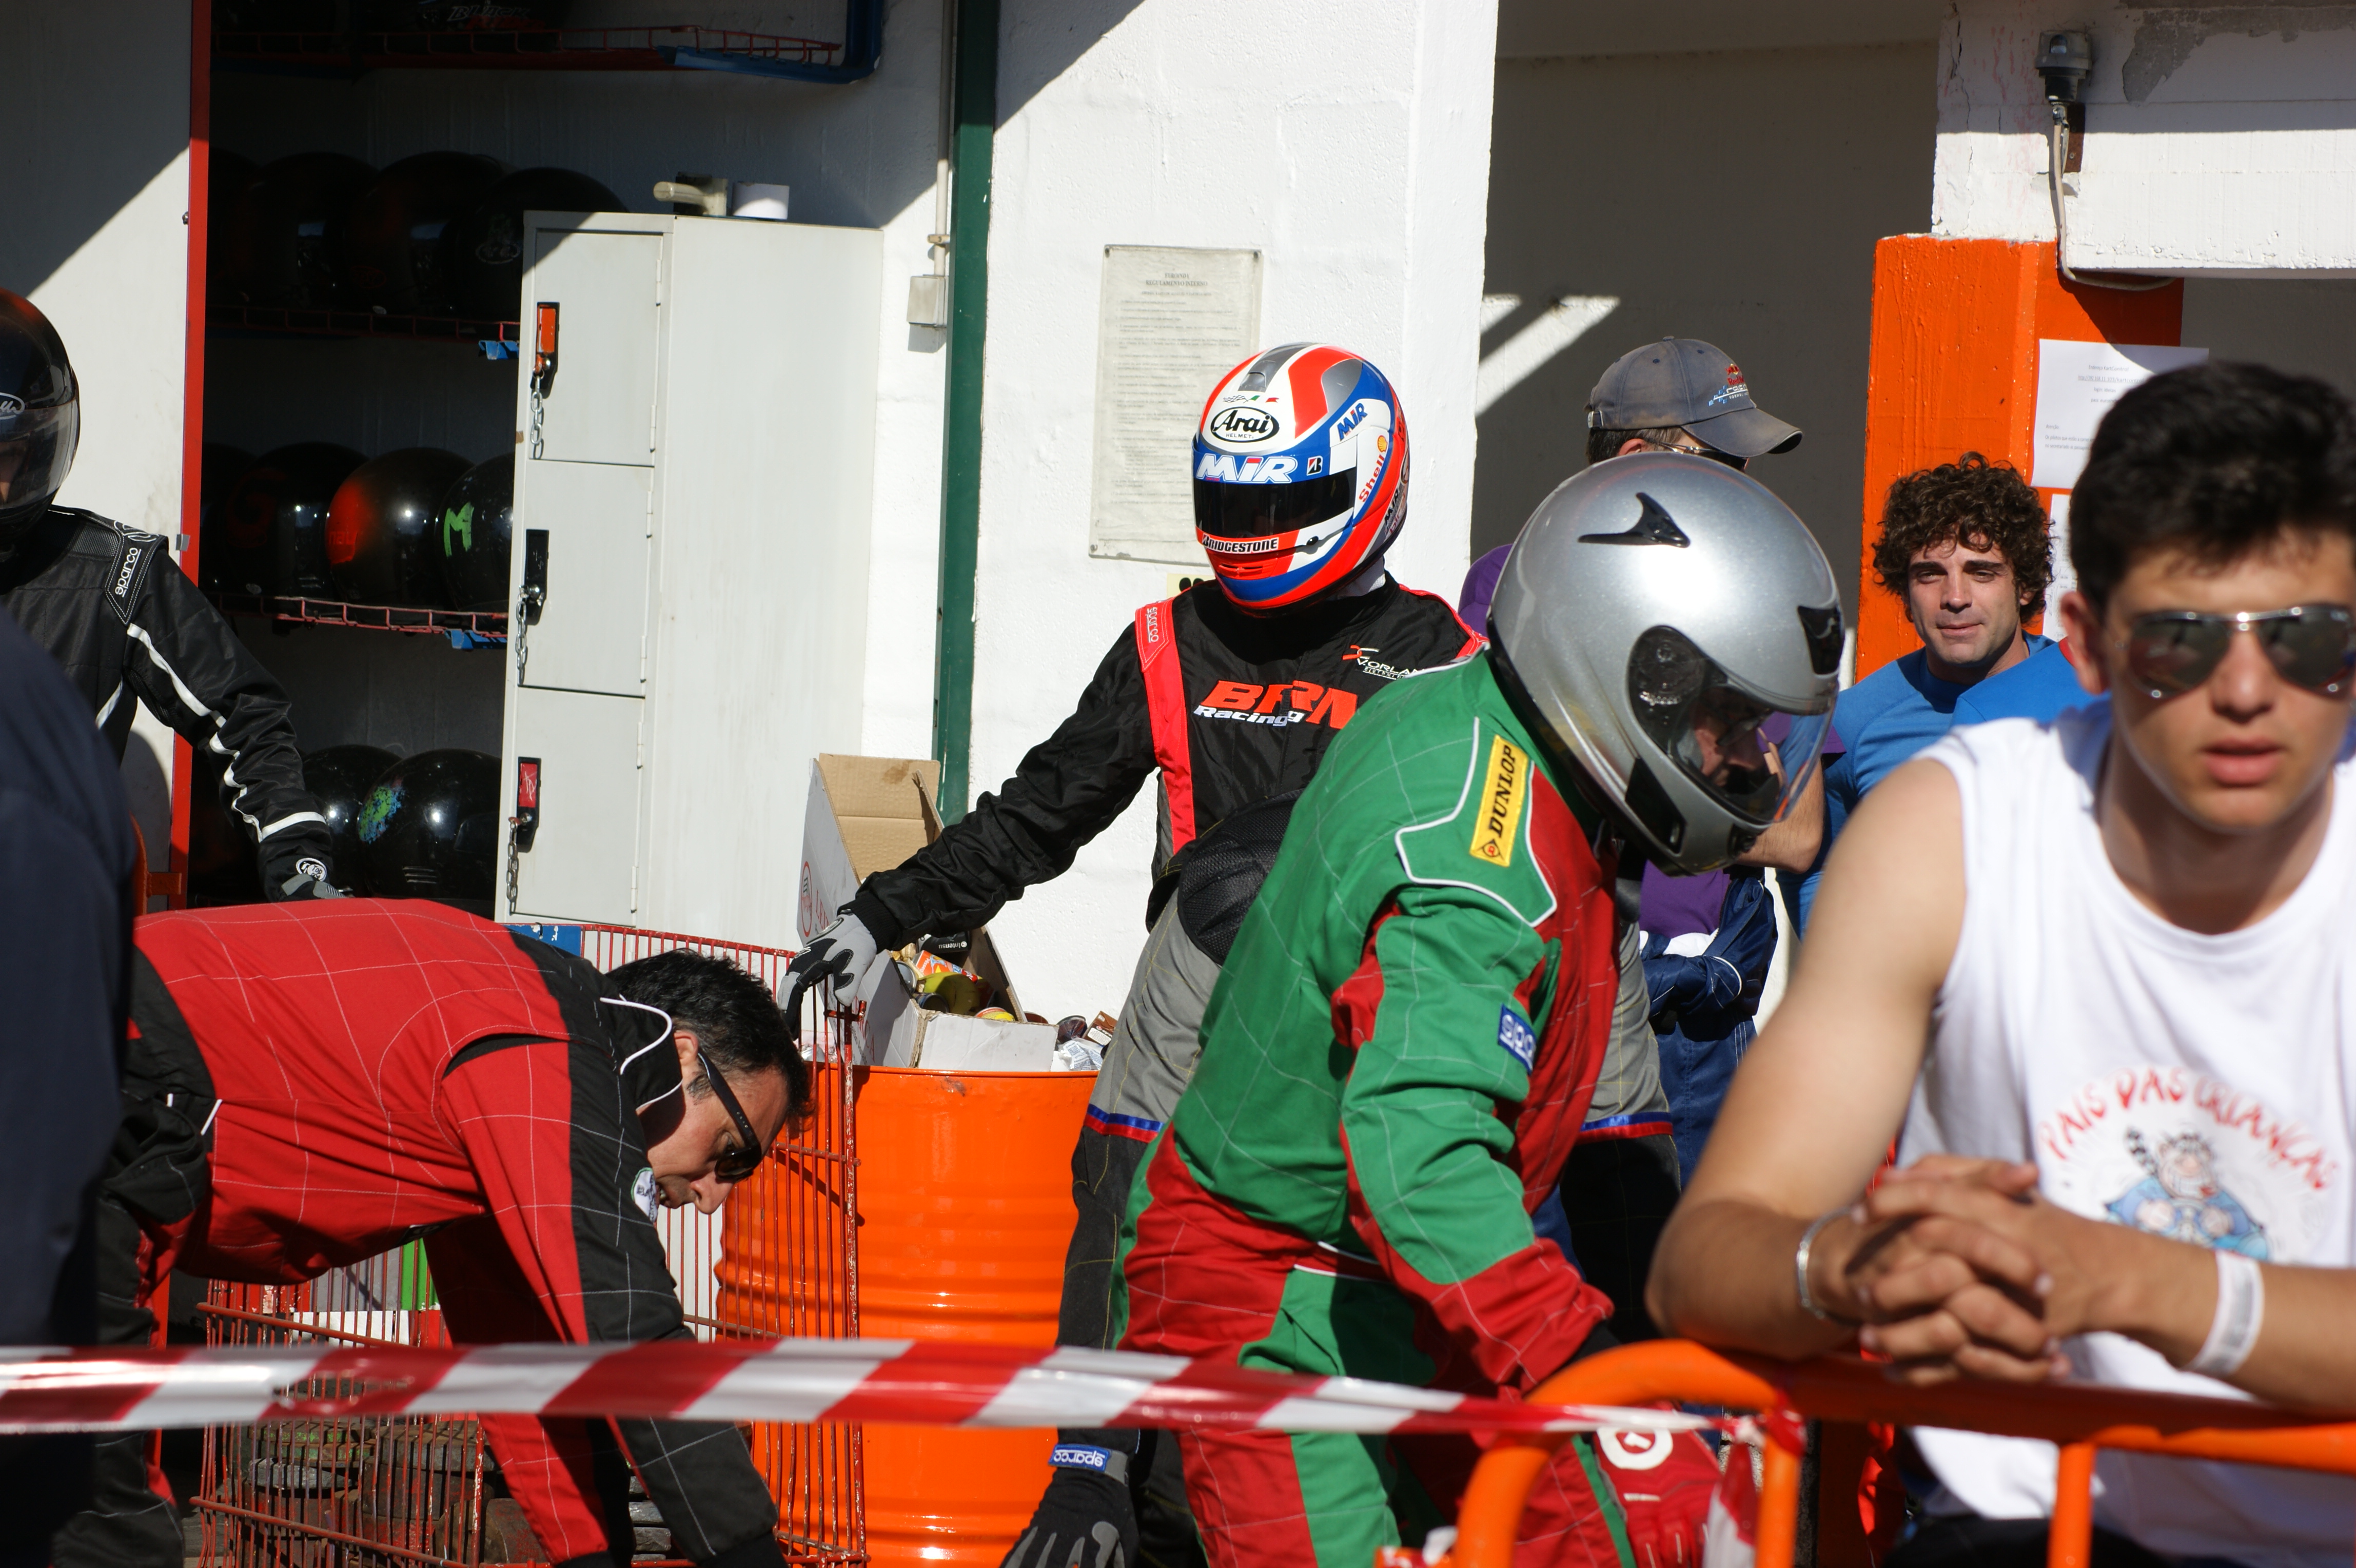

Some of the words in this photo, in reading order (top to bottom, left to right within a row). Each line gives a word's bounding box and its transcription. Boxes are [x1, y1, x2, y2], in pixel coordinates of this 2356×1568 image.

[1216, 409, 1271, 432] Arai
[1359, 454, 1386, 503] Shell
[1202, 533, 1279, 554] BRIDGESTONE
[114, 546, 142, 598] sparco
[1146, 606, 1160, 644] sparco
[1488, 744, 1517, 838] DUNLOP
[1053, 1449, 1105, 1467] sparco
